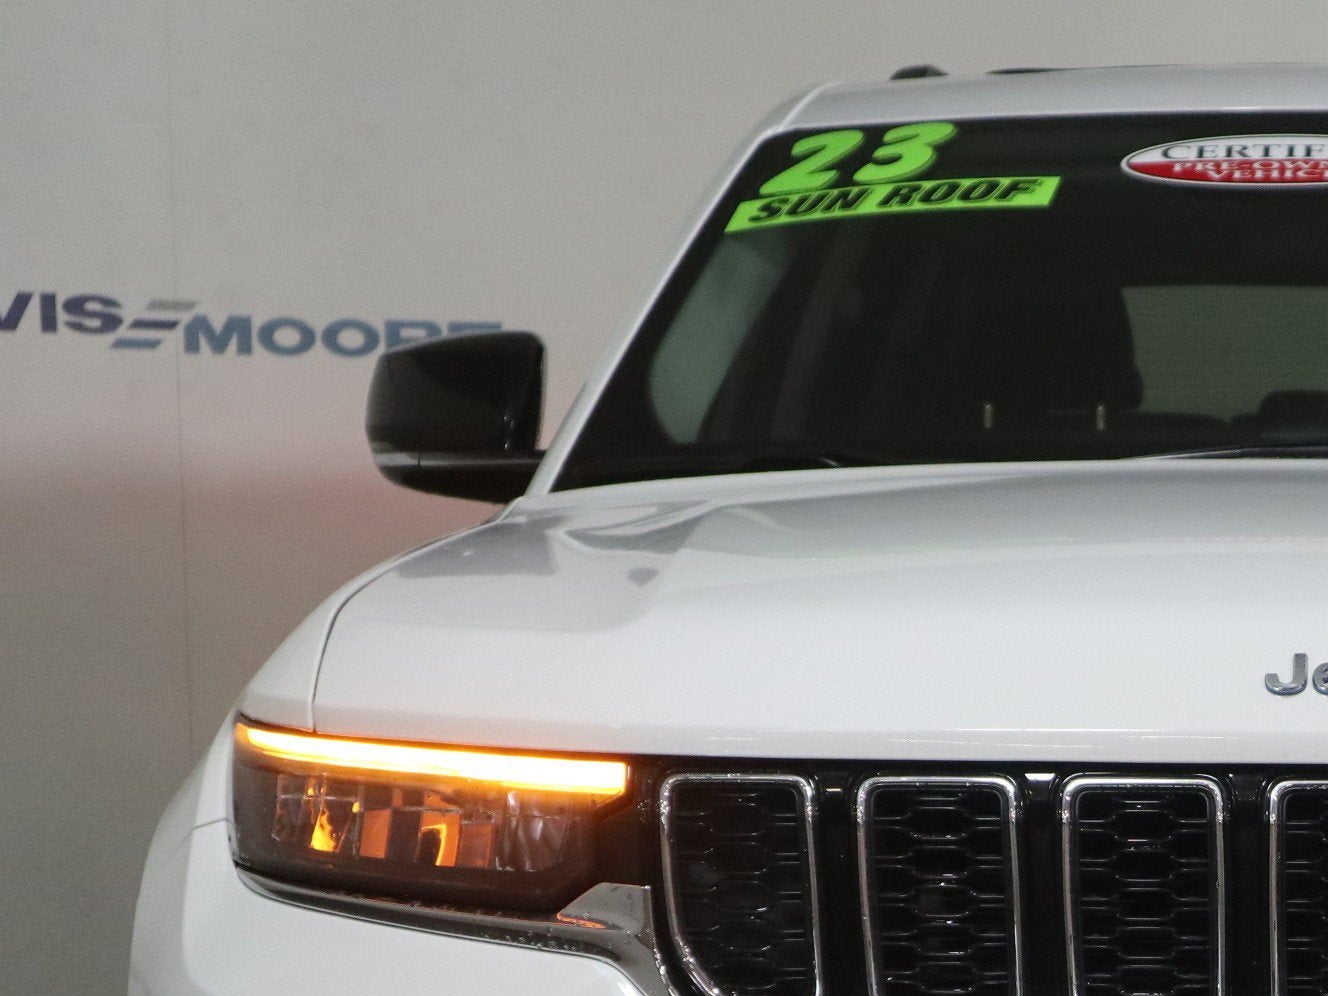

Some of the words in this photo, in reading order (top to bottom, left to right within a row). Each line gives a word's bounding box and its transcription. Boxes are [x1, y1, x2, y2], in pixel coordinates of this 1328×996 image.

[759, 121, 957, 196] 23
[748, 184, 871, 222] SUN
[876, 176, 1042, 208] ROOF
[183, 315, 502, 356] MOOR
